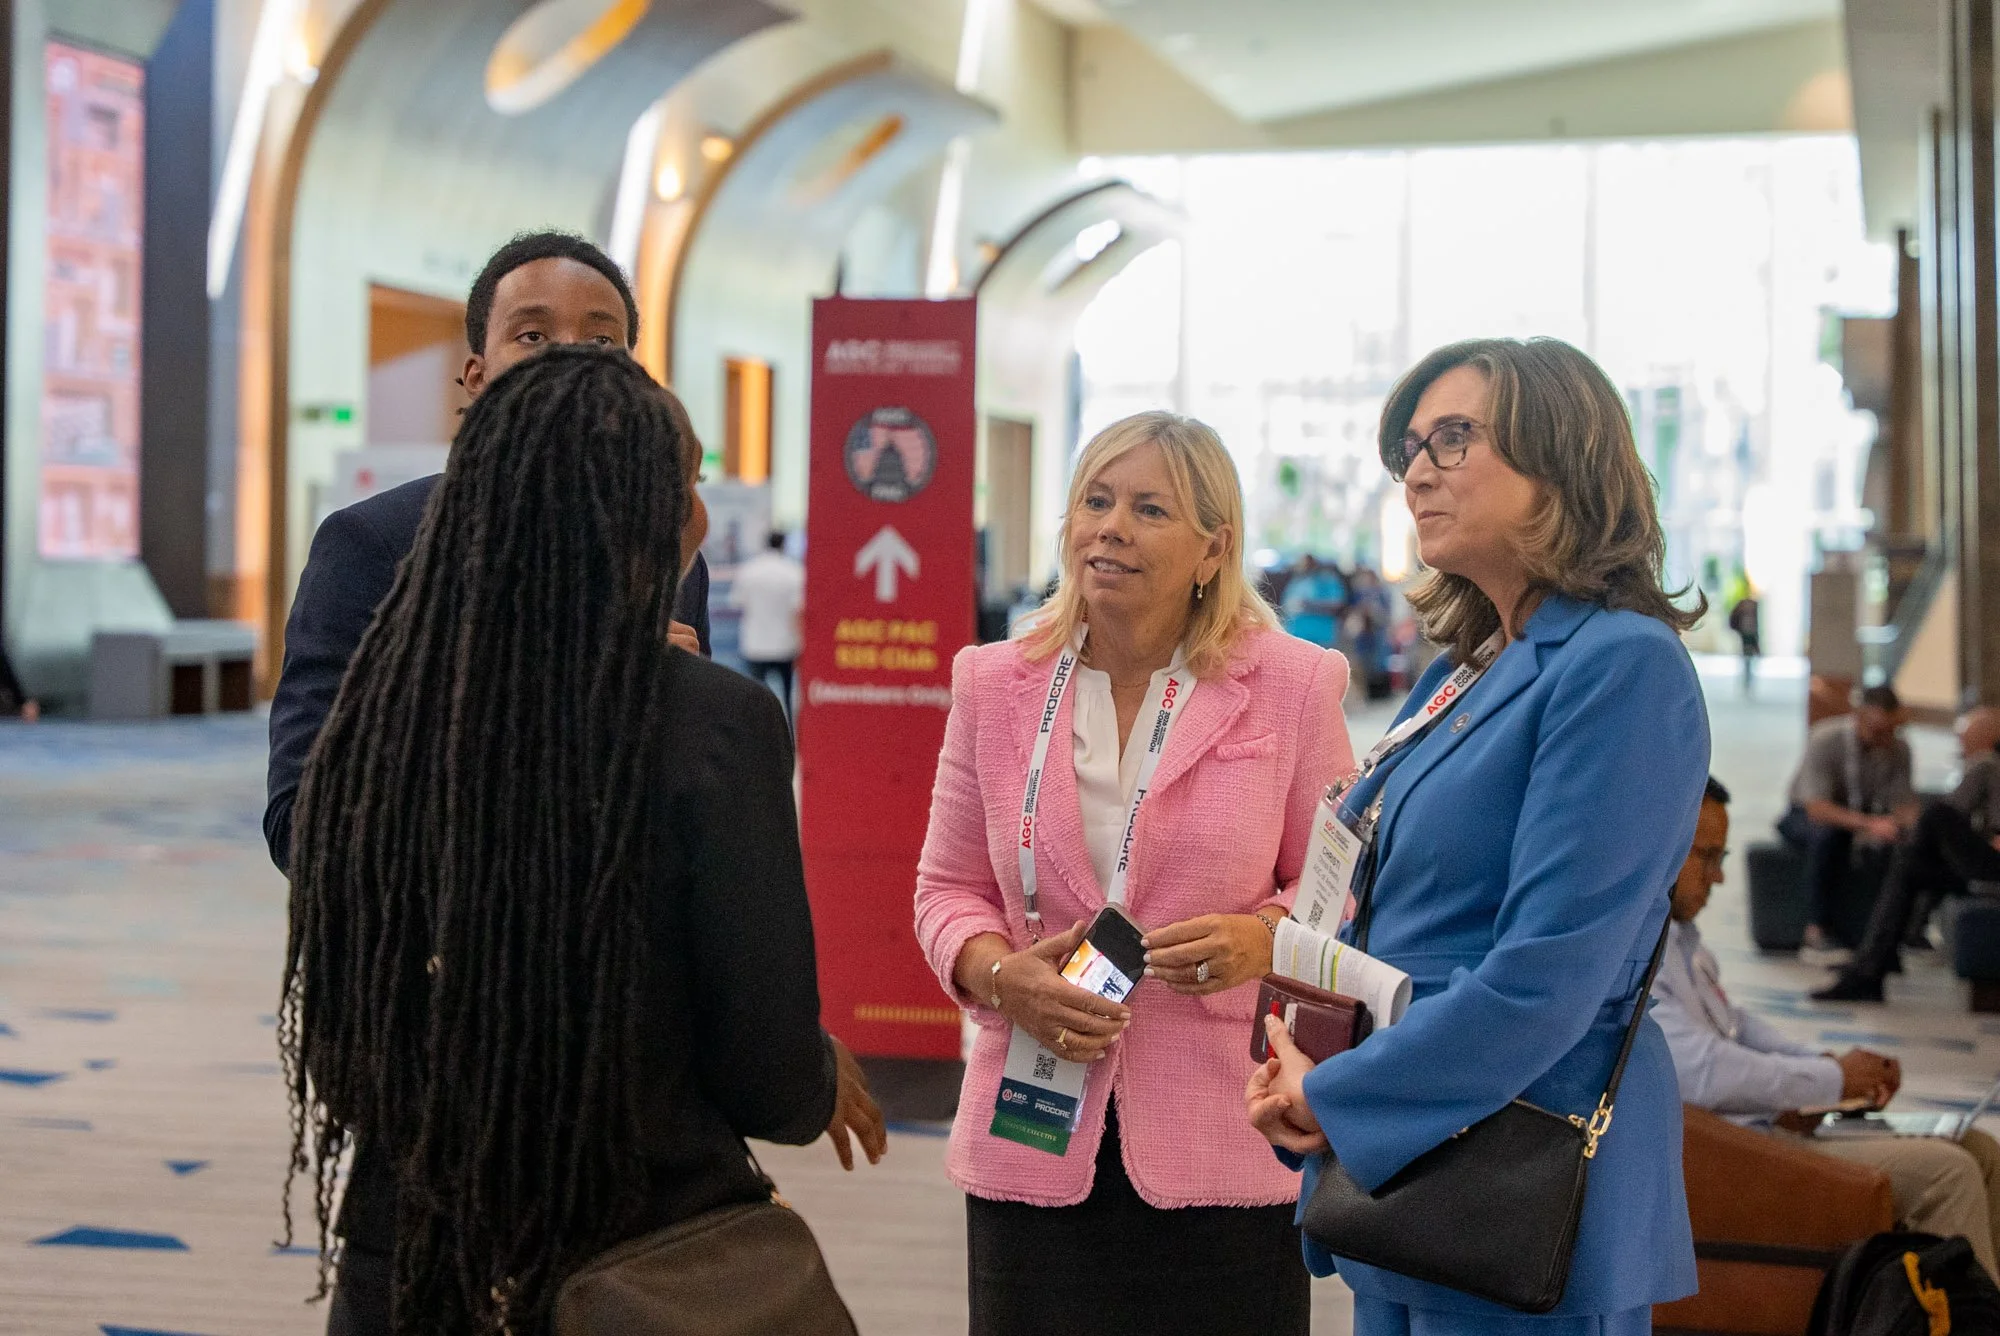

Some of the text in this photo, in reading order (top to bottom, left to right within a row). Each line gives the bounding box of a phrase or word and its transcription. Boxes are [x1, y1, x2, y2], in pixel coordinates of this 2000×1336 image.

[836, 619, 937, 643] AGC PAC
[882, 647, 937, 670] Club
[1458, 649, 1495, 687] CONVTION
[1040, 656, 1074, 733] PROCORE
[1161, 677, 1181, 728] AGC 2026
[1427, 669, 1468, 715] AGC 2026
[1148, 709, 1165, 753] CONVENTION
[1029, 768, 1040, 814] CONVENTION
[1021, 816, 1032, 849] AGC
[1013, 1091, 1028, 1101] AGC
[1034, 1102, 1071, 1119] PROCORE
[1026, 1127, 1057, 1141] EXECUTIVE
